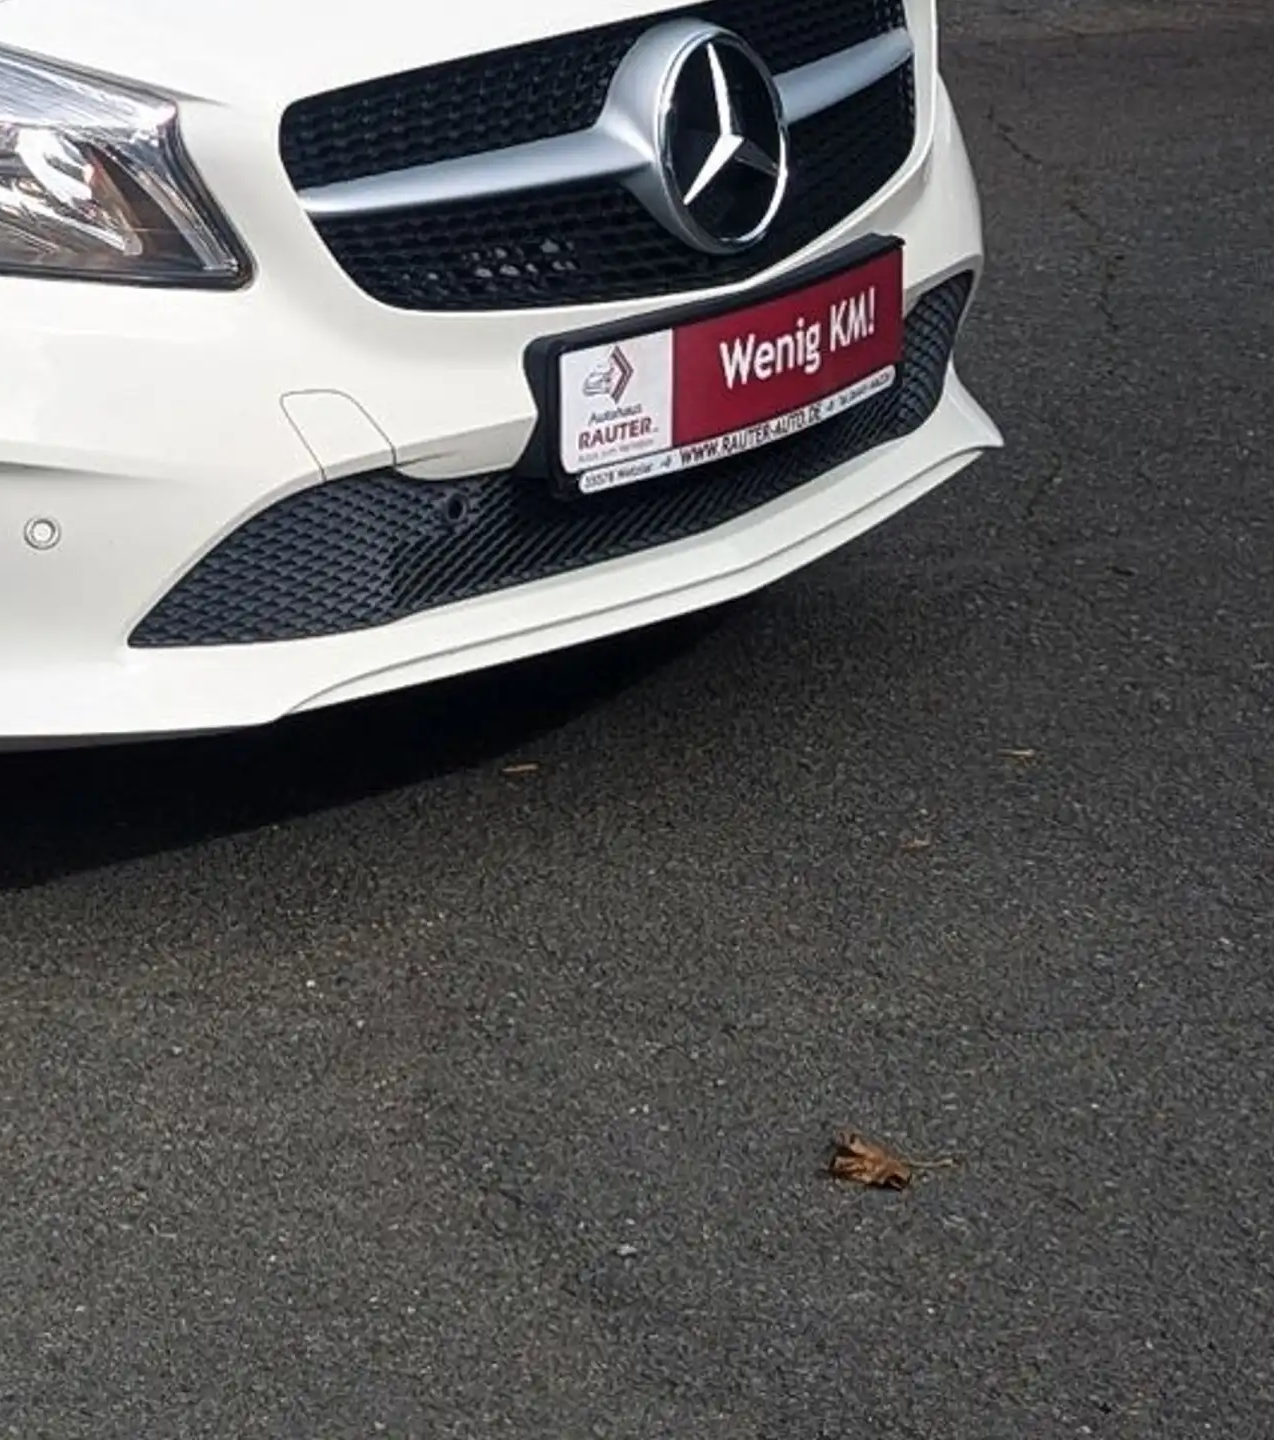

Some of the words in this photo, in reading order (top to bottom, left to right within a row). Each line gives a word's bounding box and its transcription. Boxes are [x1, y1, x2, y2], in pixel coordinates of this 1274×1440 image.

[719, 316, 822, 390] Wenig
[829, 285, 876, 353] KM!
[577, 416, 653, 451] RAUTER
